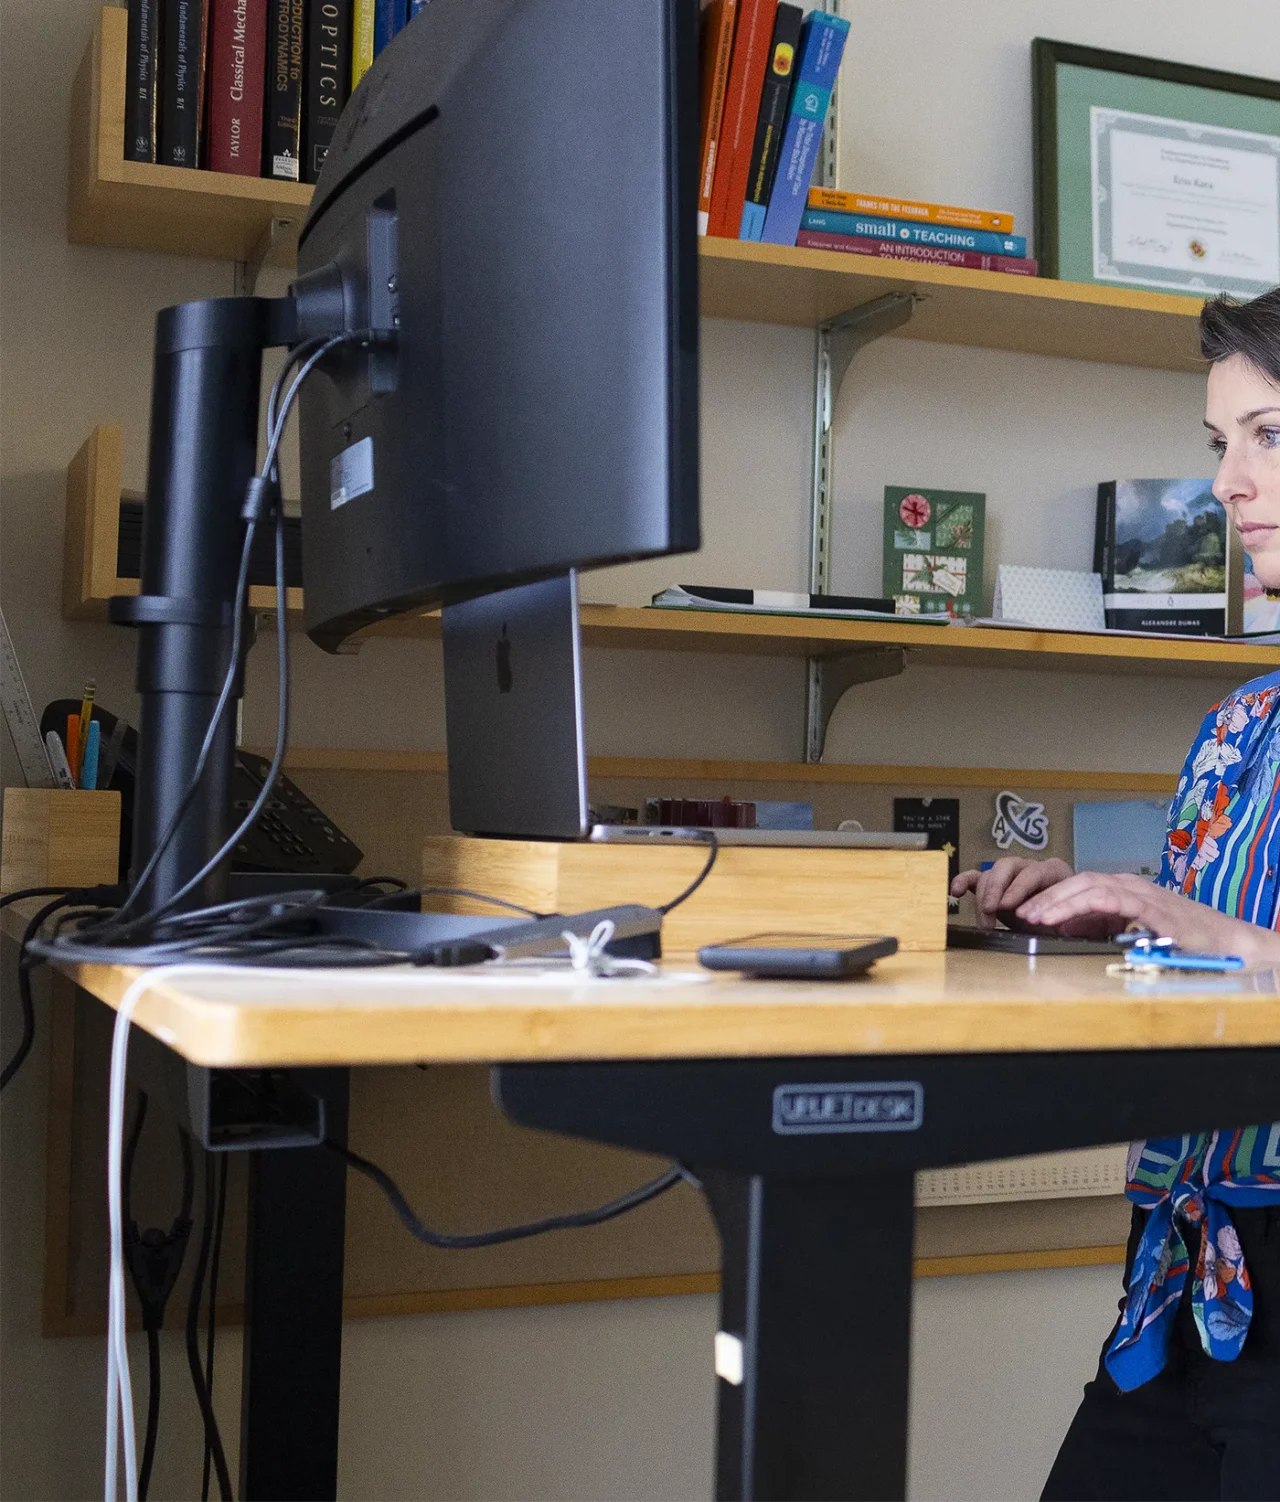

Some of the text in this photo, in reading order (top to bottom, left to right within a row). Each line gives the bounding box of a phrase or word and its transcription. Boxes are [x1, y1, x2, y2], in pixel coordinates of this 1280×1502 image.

[139, 0, 150, 41] ndamentals
[178, 1, 189, 52] Fundamentals
[360, 12, 372, 58] Physics
[139, 44, 150, 52] of
[276, 0, 290, 92] TRODYNAMICS
[290, 0, 303, 80] ODUCTION to
[320, 4, 339, 107] OPTICS
[137, 54, 149, 80] Physics
[178, 54, 187, 63] of
[176, 64, 187, 91] Physics
[230, 0, 247, 158] TAYLOR Classical Mecha
[808, 218, 826, 226] LANG
[855, 219, 976, 248] small TEACHING
[880, 243, 965, 263] AN INTRODUCTION
